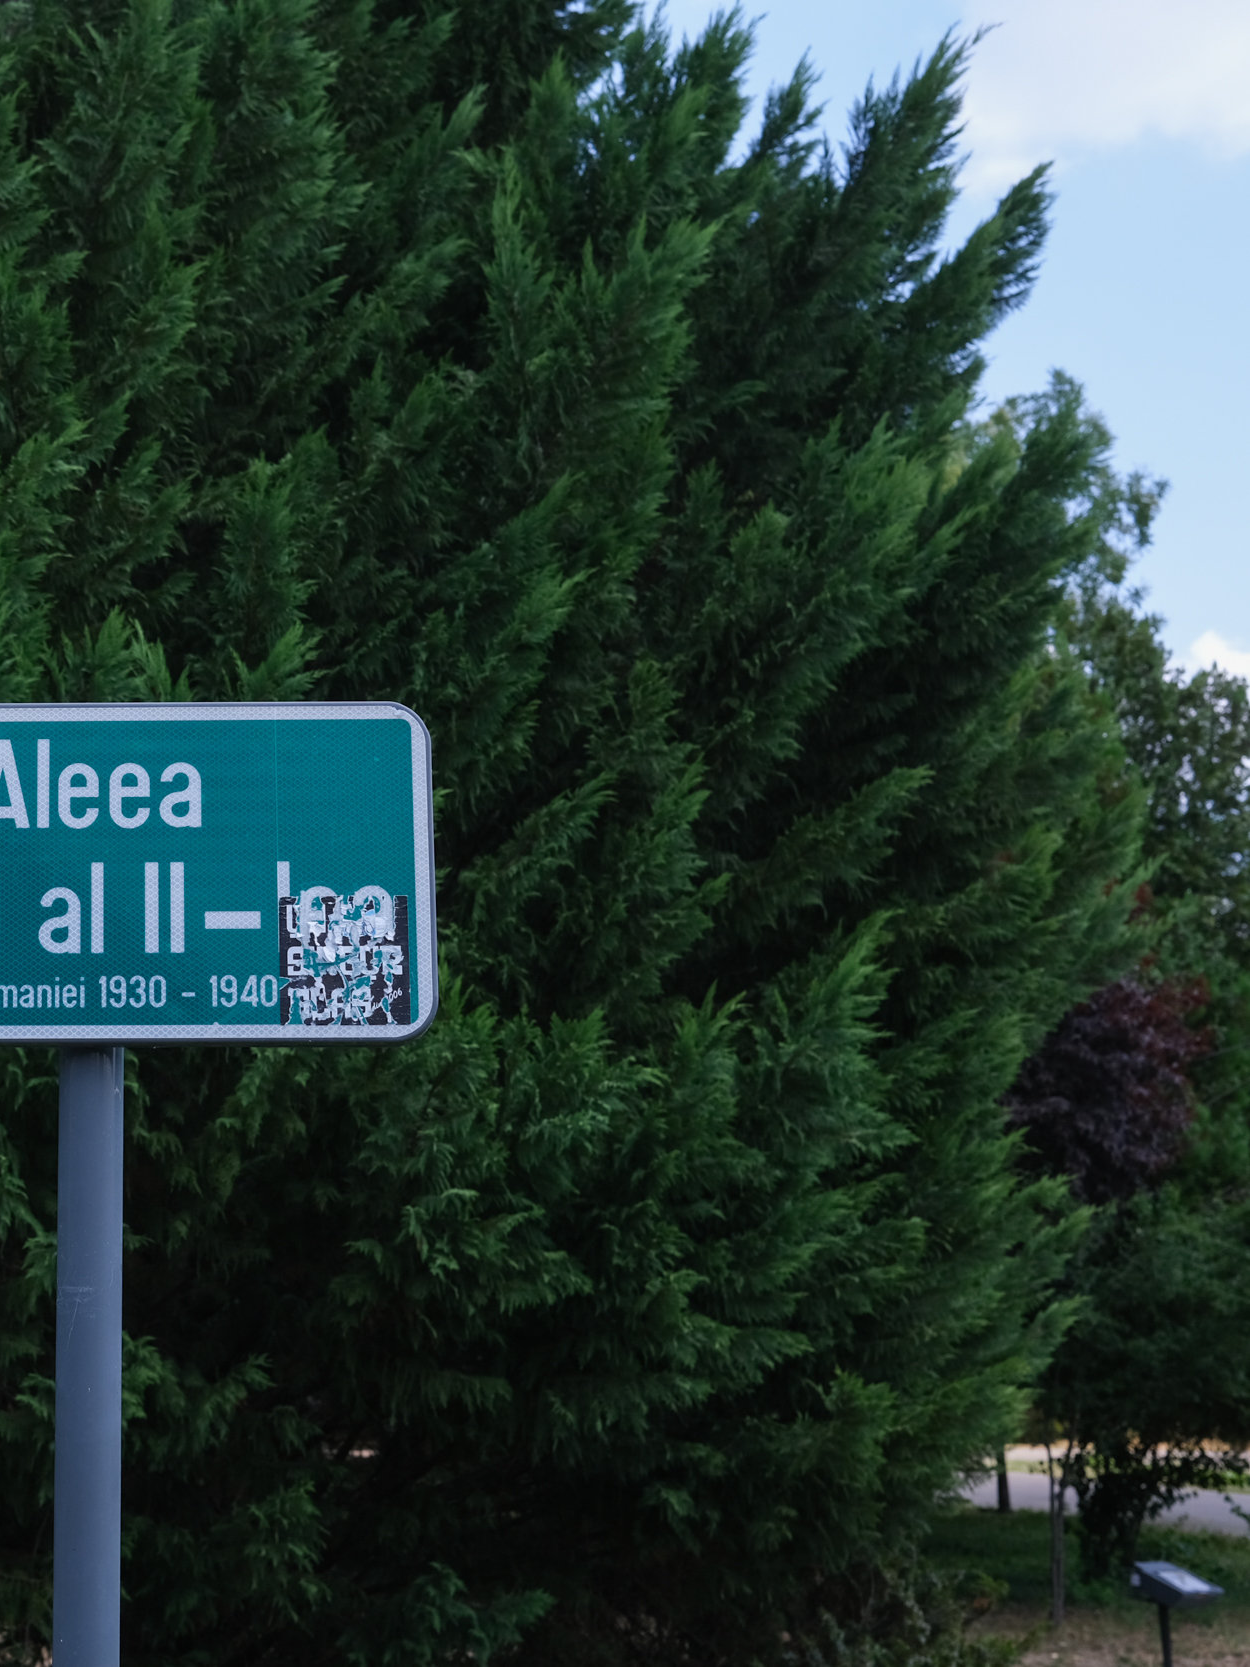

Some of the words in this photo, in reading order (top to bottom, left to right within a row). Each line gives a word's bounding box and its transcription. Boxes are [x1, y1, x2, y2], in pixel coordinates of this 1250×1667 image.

[38, 862, 105, 954] al
[99, 975, 167, 1009] 1930
[210, 975, 278, 1008] 1940
